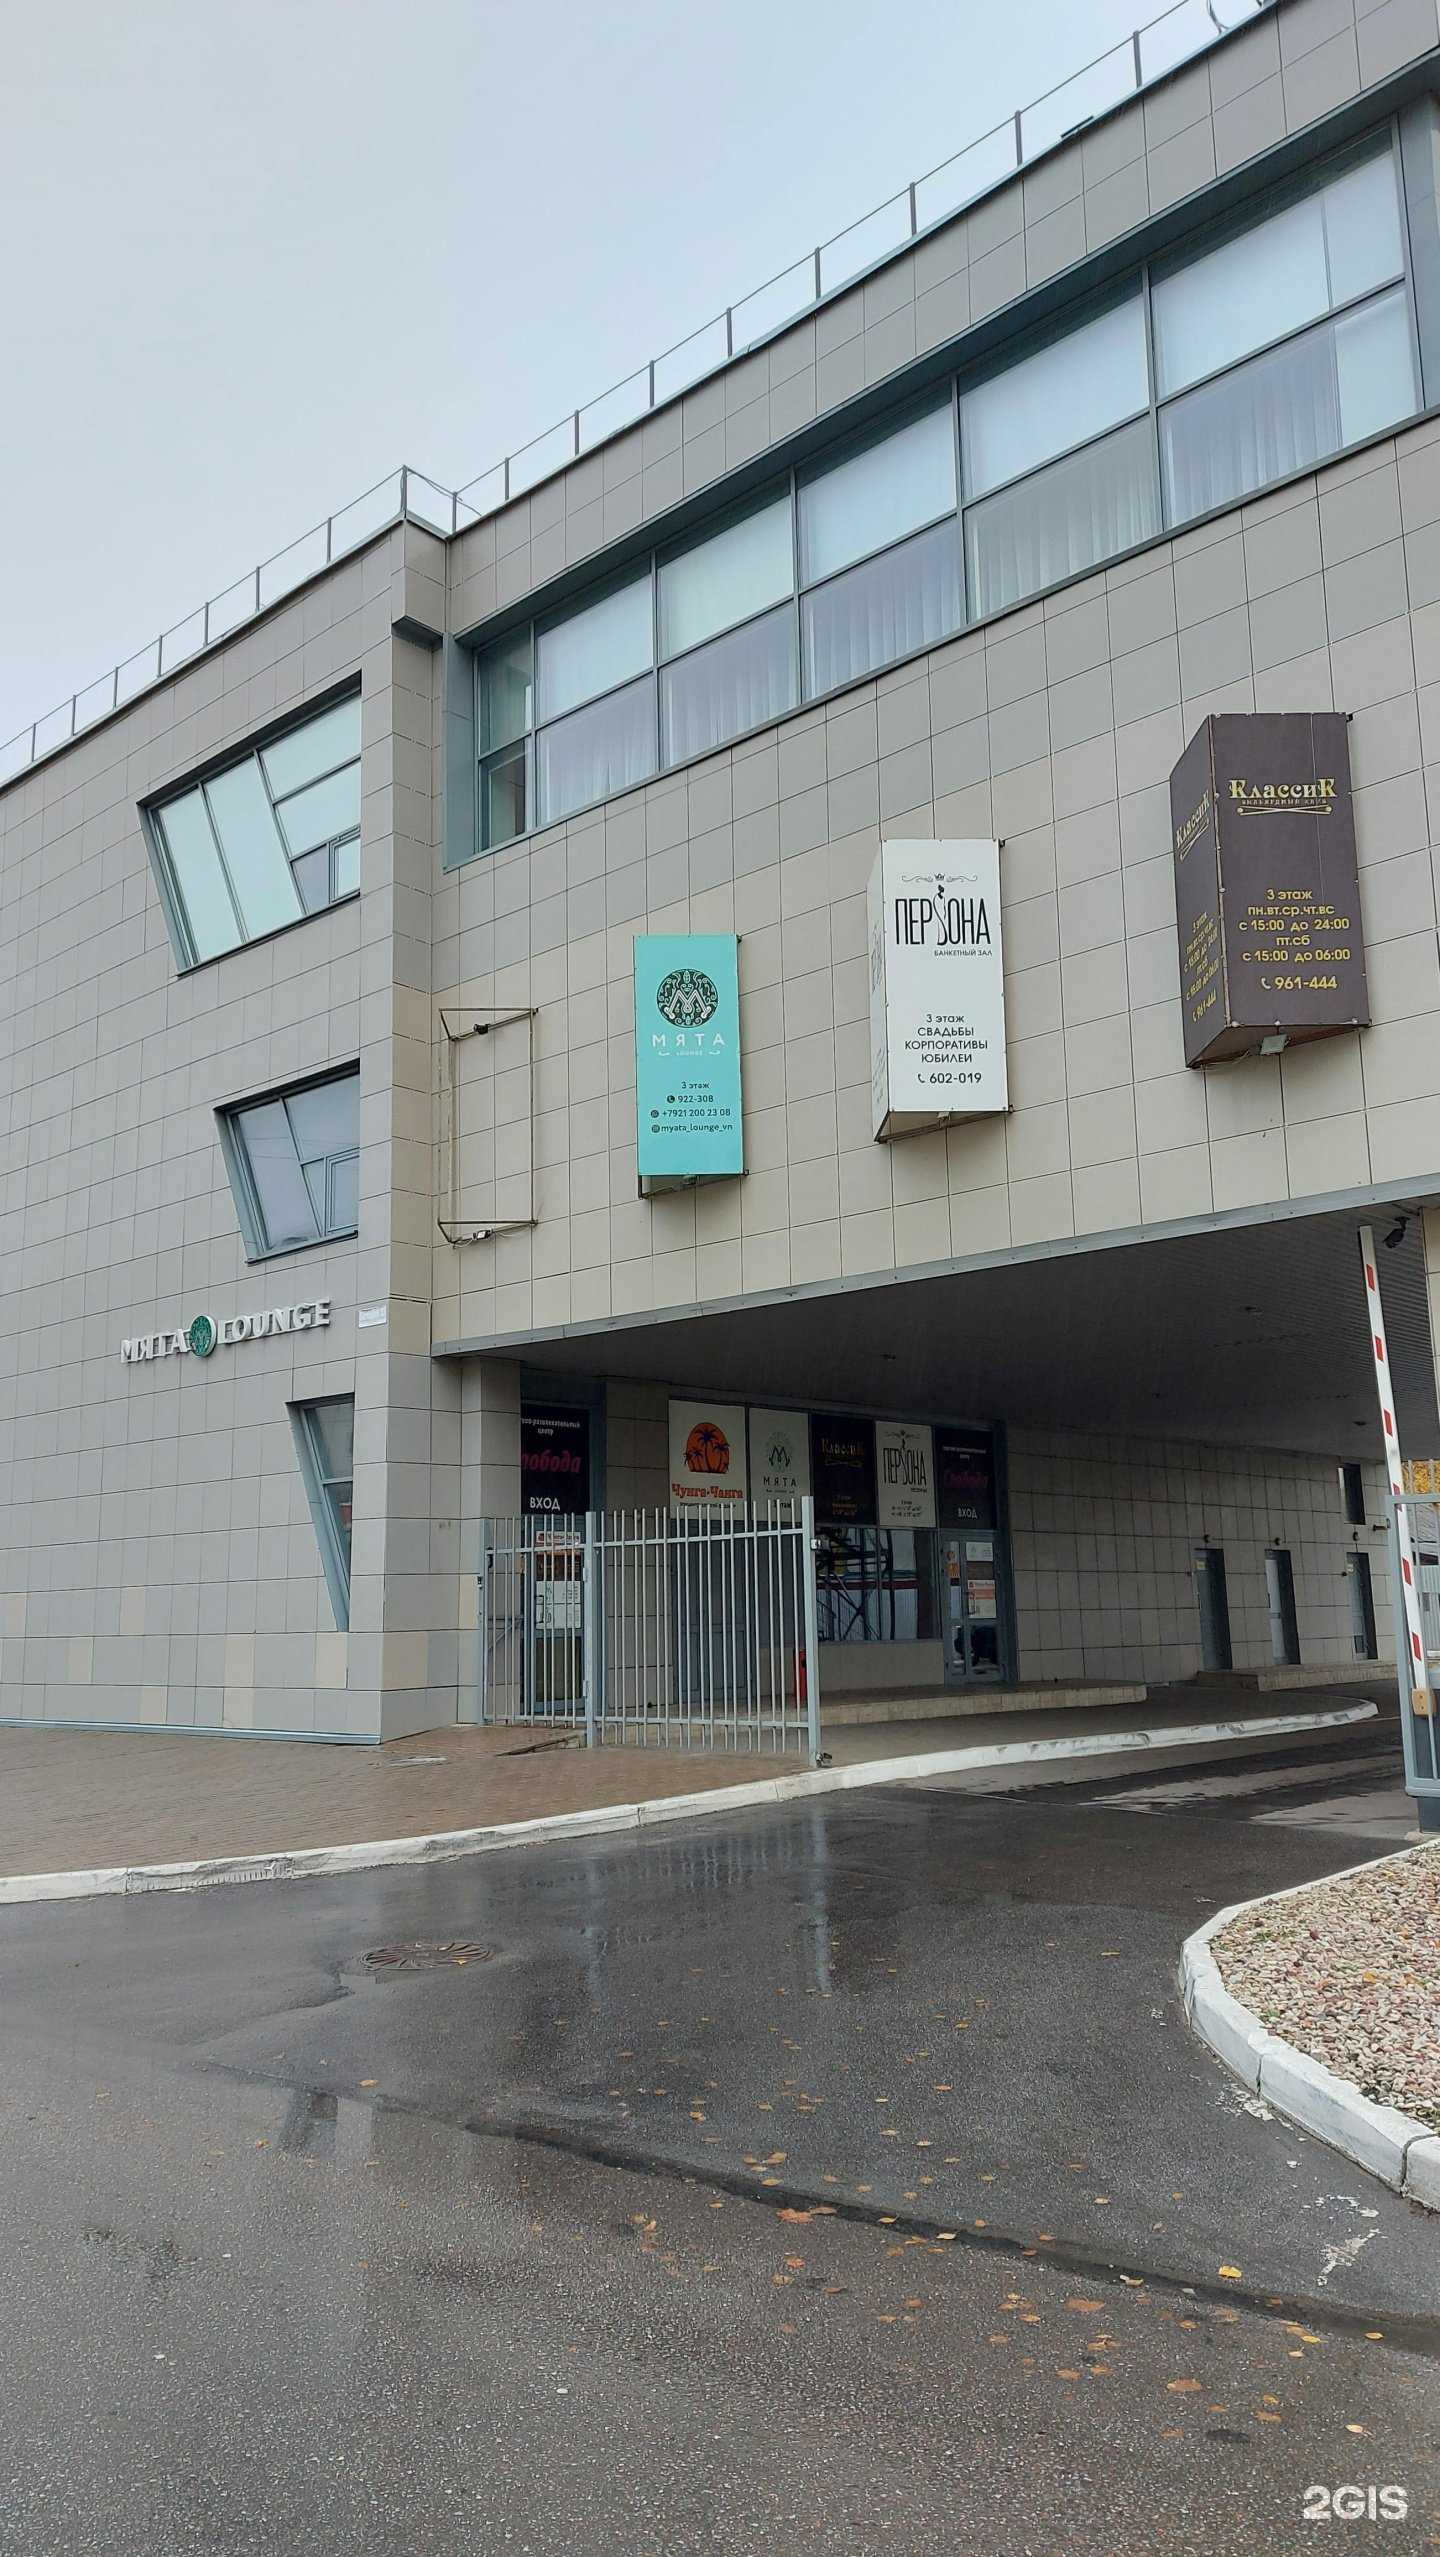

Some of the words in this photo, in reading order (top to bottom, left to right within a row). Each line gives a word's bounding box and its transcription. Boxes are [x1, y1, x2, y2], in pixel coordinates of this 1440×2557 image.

[1266, 889, 1275, 900] 3
[1277, 890, 1313, 900] этаж
[1251, 919, 1285, 931] 15:00
[1290, 921, 1309, 932] до
[1314, 918, 1350, 930] 24:00
[1276, 934, 1311, 946] пт.сб
[977, 949, 992, 957] ЗАЛ
[1254, 950, 1289, 962] 15:00
[1294, 952, 1313, 963] до
[1315, 949, 1351, 961] 06:00
[1274, 976, 1338, 990] 961-444
[926, 1013, 932, 1023] 3
[935, 1015, 965, 1023] этаж
[917, 1026, 974, 1037] СВАДЬБЫ
[652, 1032, 725, 1048] МЯТА
[904, 1040, 988, 1050] КОРПОРАТИВЫ
[929, 1072, 982, 1084] 602-019
[681, 1081, 687, 1089] 3
[689, 1108, 705, 1117] 200
[707, 1108, 717, 1117] 23
[120, 1328, 192, 1363] МЯТА
[217, 1298, 330, 1344] LOUNGE
[763, 1476, 797, 1487] МЯТА
[529, 1496, 560, 1511] ВХОД
